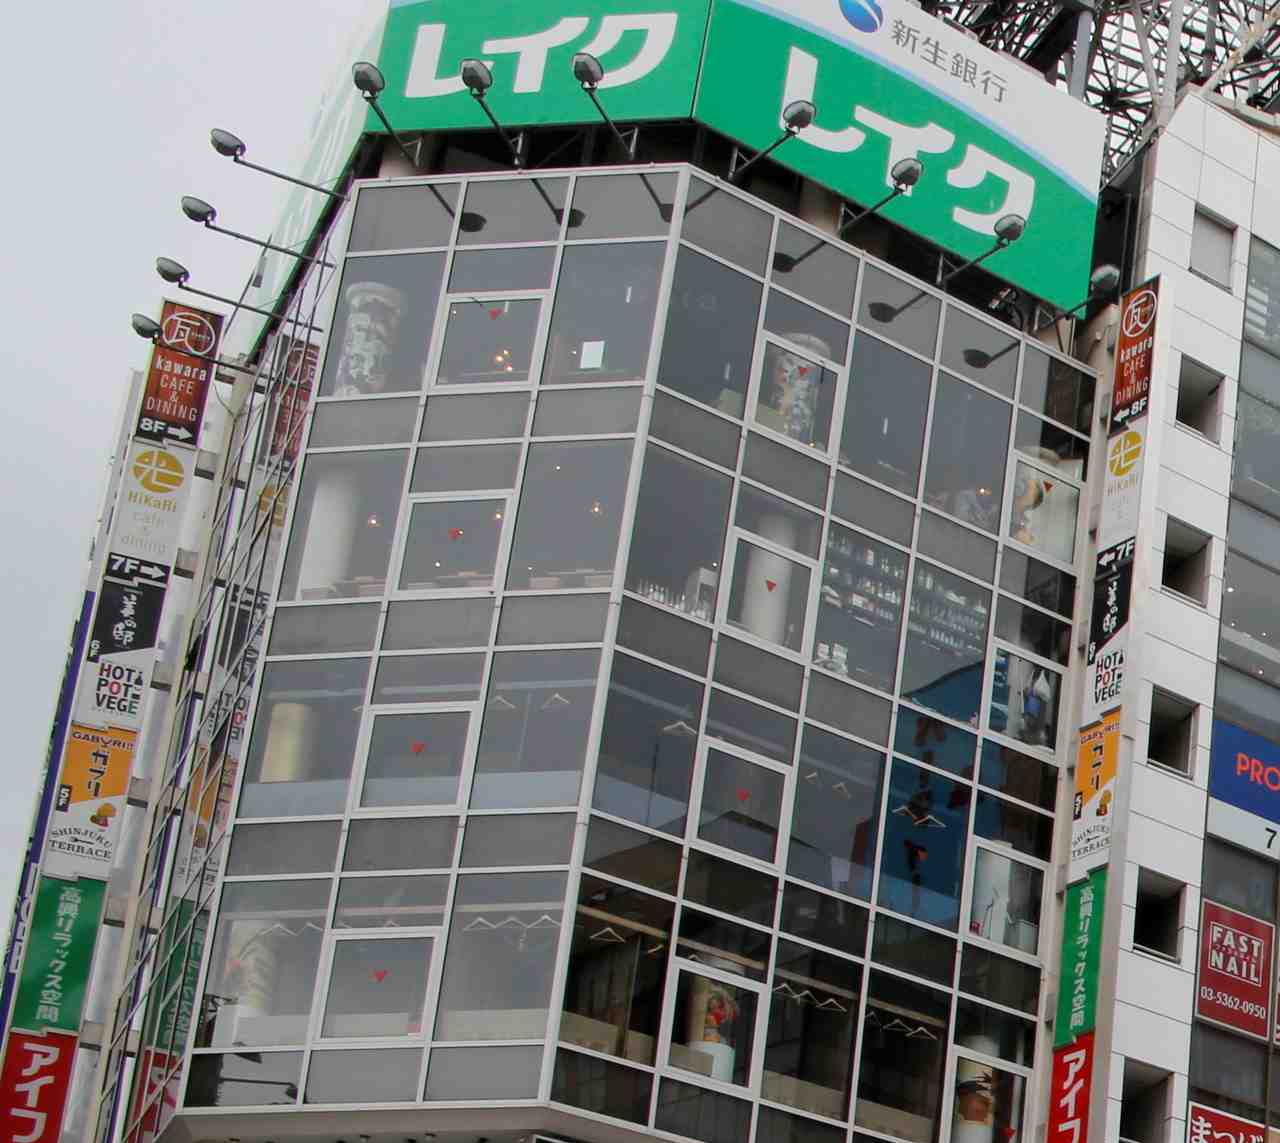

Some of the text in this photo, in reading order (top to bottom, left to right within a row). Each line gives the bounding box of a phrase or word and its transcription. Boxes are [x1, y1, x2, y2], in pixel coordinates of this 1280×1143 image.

[404, 12, 678, 98] レイク
[891, 18, 1008, 103] 新生銀行
[779, 45, 1036, 236] レイク
[156, 355, 208, 380] kawara
[160, 375, 194, 395] CAFE
[1115, 380, 1149, 404] DINING
[146, 396, 199, 422] DINING
[1130, 397, 1147, 416] 8F
[140, 417, 166, 433] 8F
[111, 555, 141, 573] 7F
[99, 663, 135, 683] HOT
[1096, 650, 1119, 675] HOT
[97, 677, 133, 697] POT
[1096, 668, 1118, 689] POT
[95, 692, 139, 715] VEGE
[1095, 681, 1120, 704] VEGE
[51, 826, 113, 848] SHINJUKU
[48, 839, 112, 860] TERRACE
[1211, 924, 1262, 954] FAST
[1210, 949, 1261, 985] NAIL
